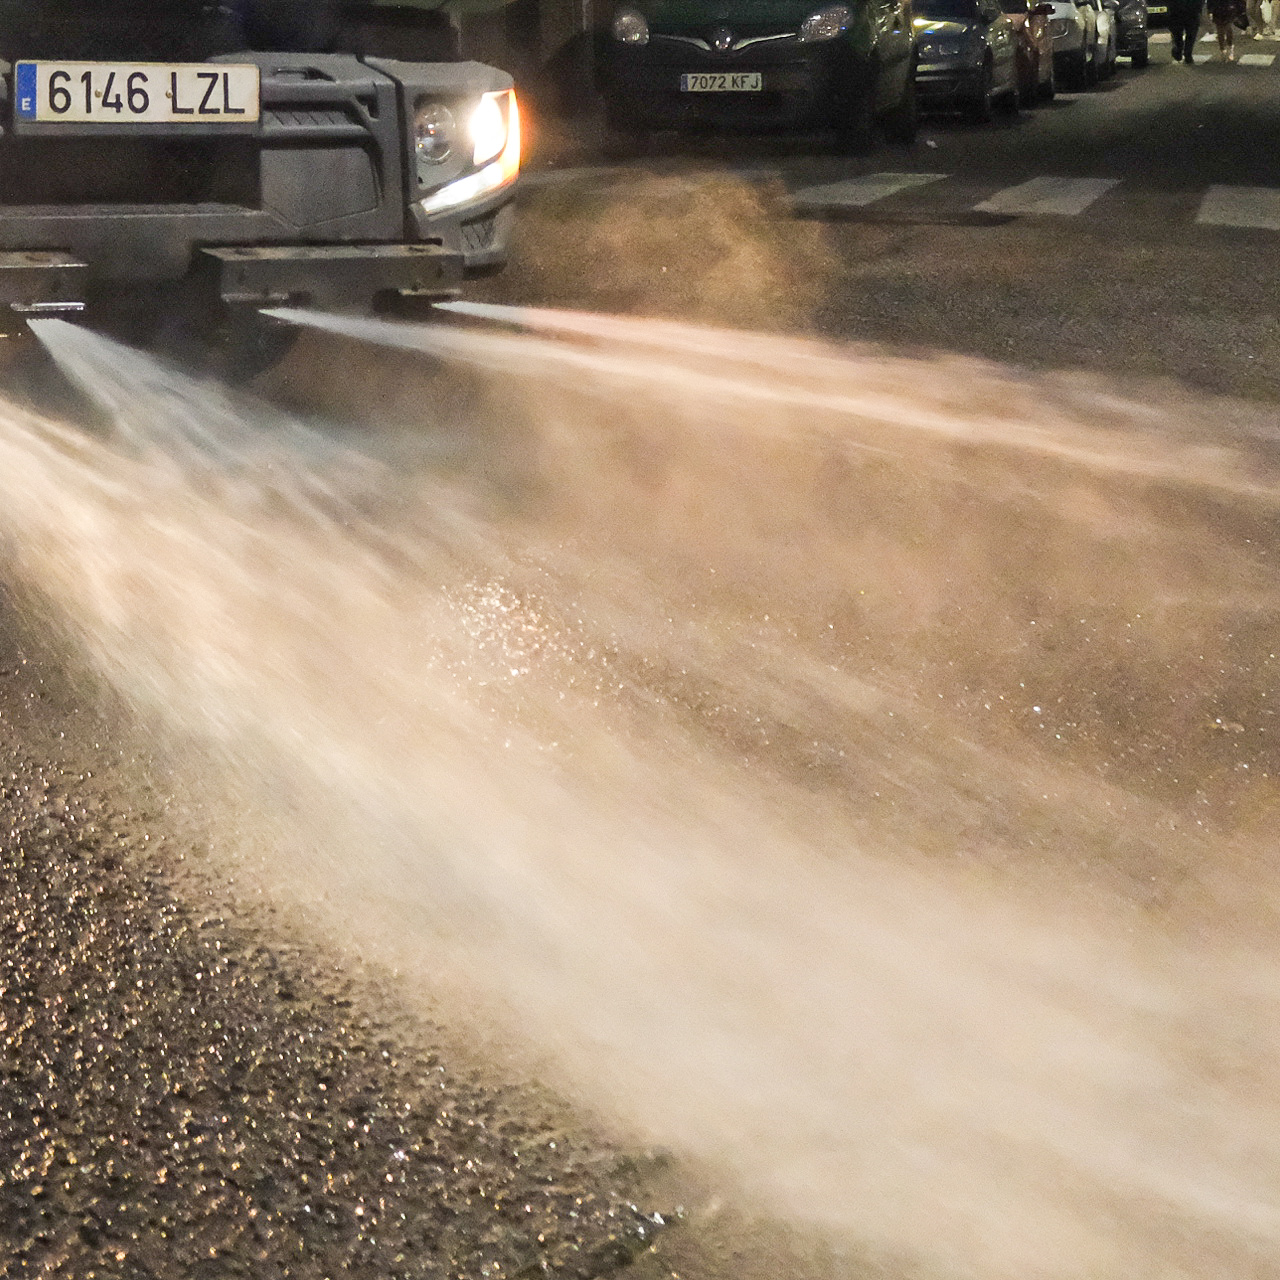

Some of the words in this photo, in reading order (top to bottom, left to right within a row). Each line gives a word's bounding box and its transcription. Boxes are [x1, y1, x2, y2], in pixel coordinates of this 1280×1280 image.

[21, 98, 31, 111] E
[48, 70, 150, 114] 6146
[171, 71, 245, 114] LZL
[691, 75, 726, 90] 7072
[731, 75, 759, 89] KFJ
